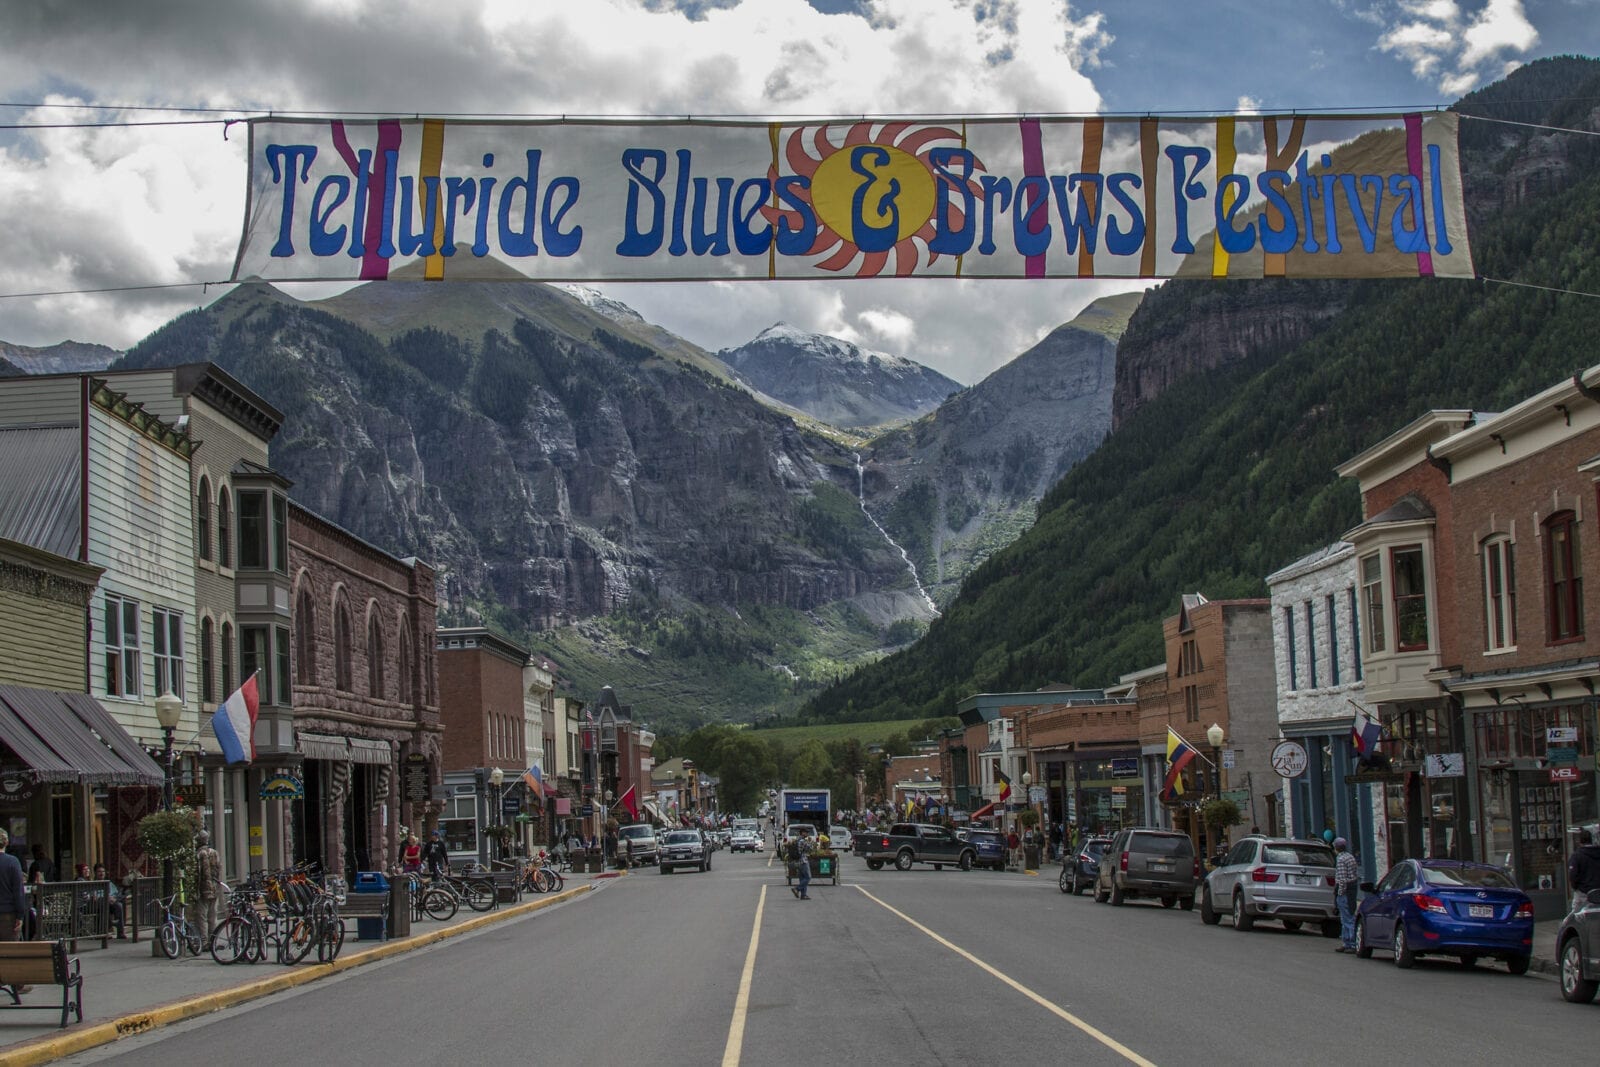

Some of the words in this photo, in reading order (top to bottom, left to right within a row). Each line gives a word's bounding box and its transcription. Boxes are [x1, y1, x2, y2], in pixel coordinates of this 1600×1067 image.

[265, 144, 582, 258] Telluride
[616, 147, 816, 258] Blues
[851, 144, 902, 253] &
[928, 146, 1145, 257] Brews
[1163, 142, 1454, 256] Festival
[116, 550, 175, 593] SALOON
[1551, 768, 1577, 777] MSL
